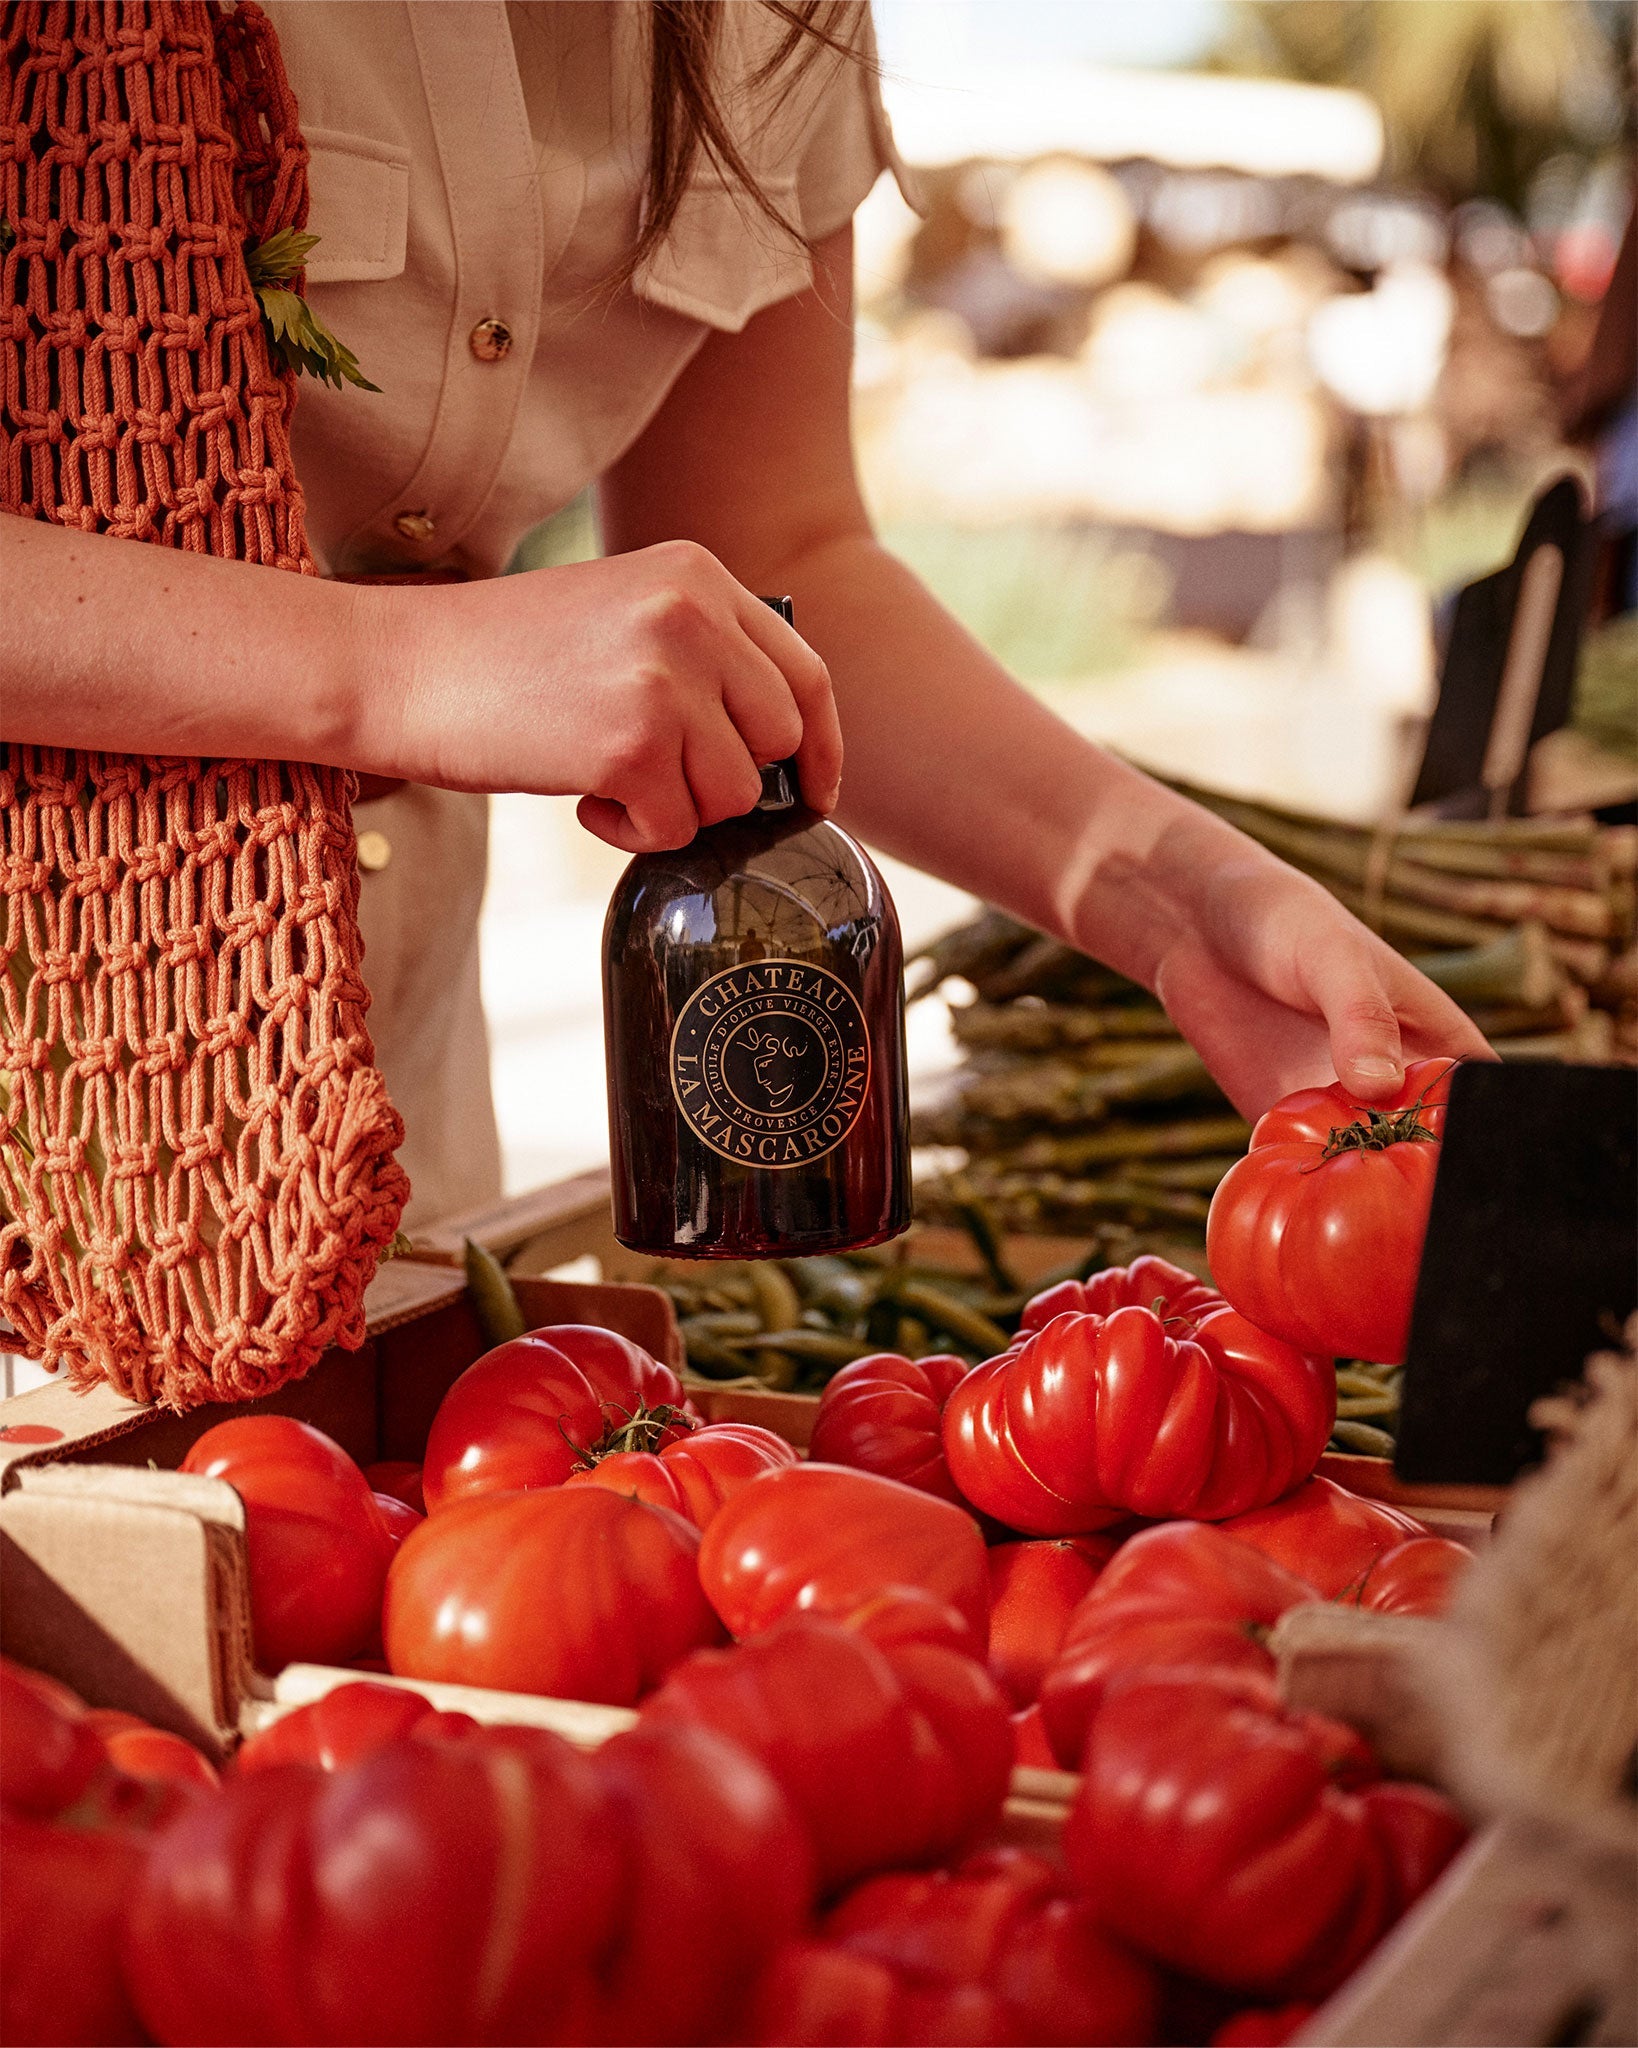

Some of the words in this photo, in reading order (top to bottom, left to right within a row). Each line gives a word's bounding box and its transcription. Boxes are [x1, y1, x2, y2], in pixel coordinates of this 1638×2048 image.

[700, 968, 846, 1017] CHATEAU
[708, 1043, 722, 1092] HUILE
[717, 999, 774, 1037] D'OLIVE
[784, 999, 829, 1034] VIERGE
[827, 1039, 840, 1089] EXTRA
[677, 1053, 701, 1098] LA
[691, 1046, 865, 1161] MASCARONNE
[732, 1105, 818, 1129] PROVENCE
